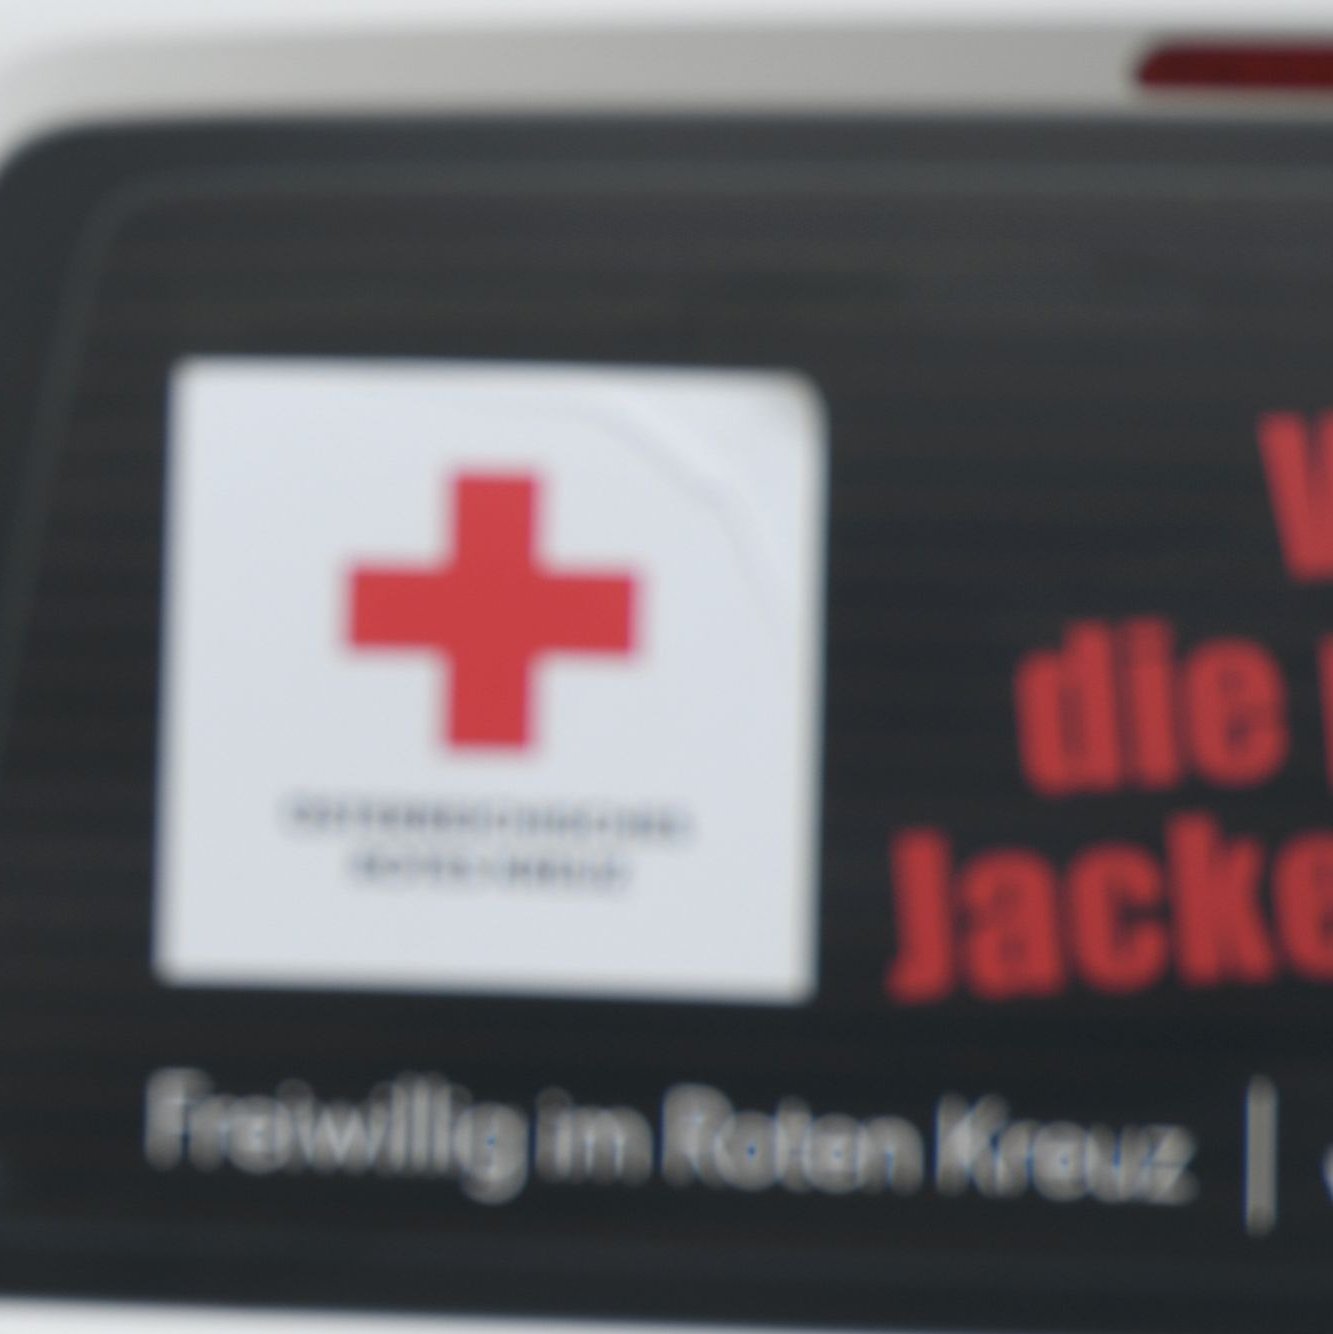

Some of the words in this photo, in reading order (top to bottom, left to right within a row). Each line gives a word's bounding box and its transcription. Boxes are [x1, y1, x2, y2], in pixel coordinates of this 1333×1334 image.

[1018, 621, 1287, 793] die
[889, 813, 1333, 1000] Jacke
[144, 1066, 528, 1203] Freiwillig
[534, 1088, 652, 1183] im
[659, 1084, 923, 1190] Roten
[933, 1094, 1195, 1204] Kreuz
